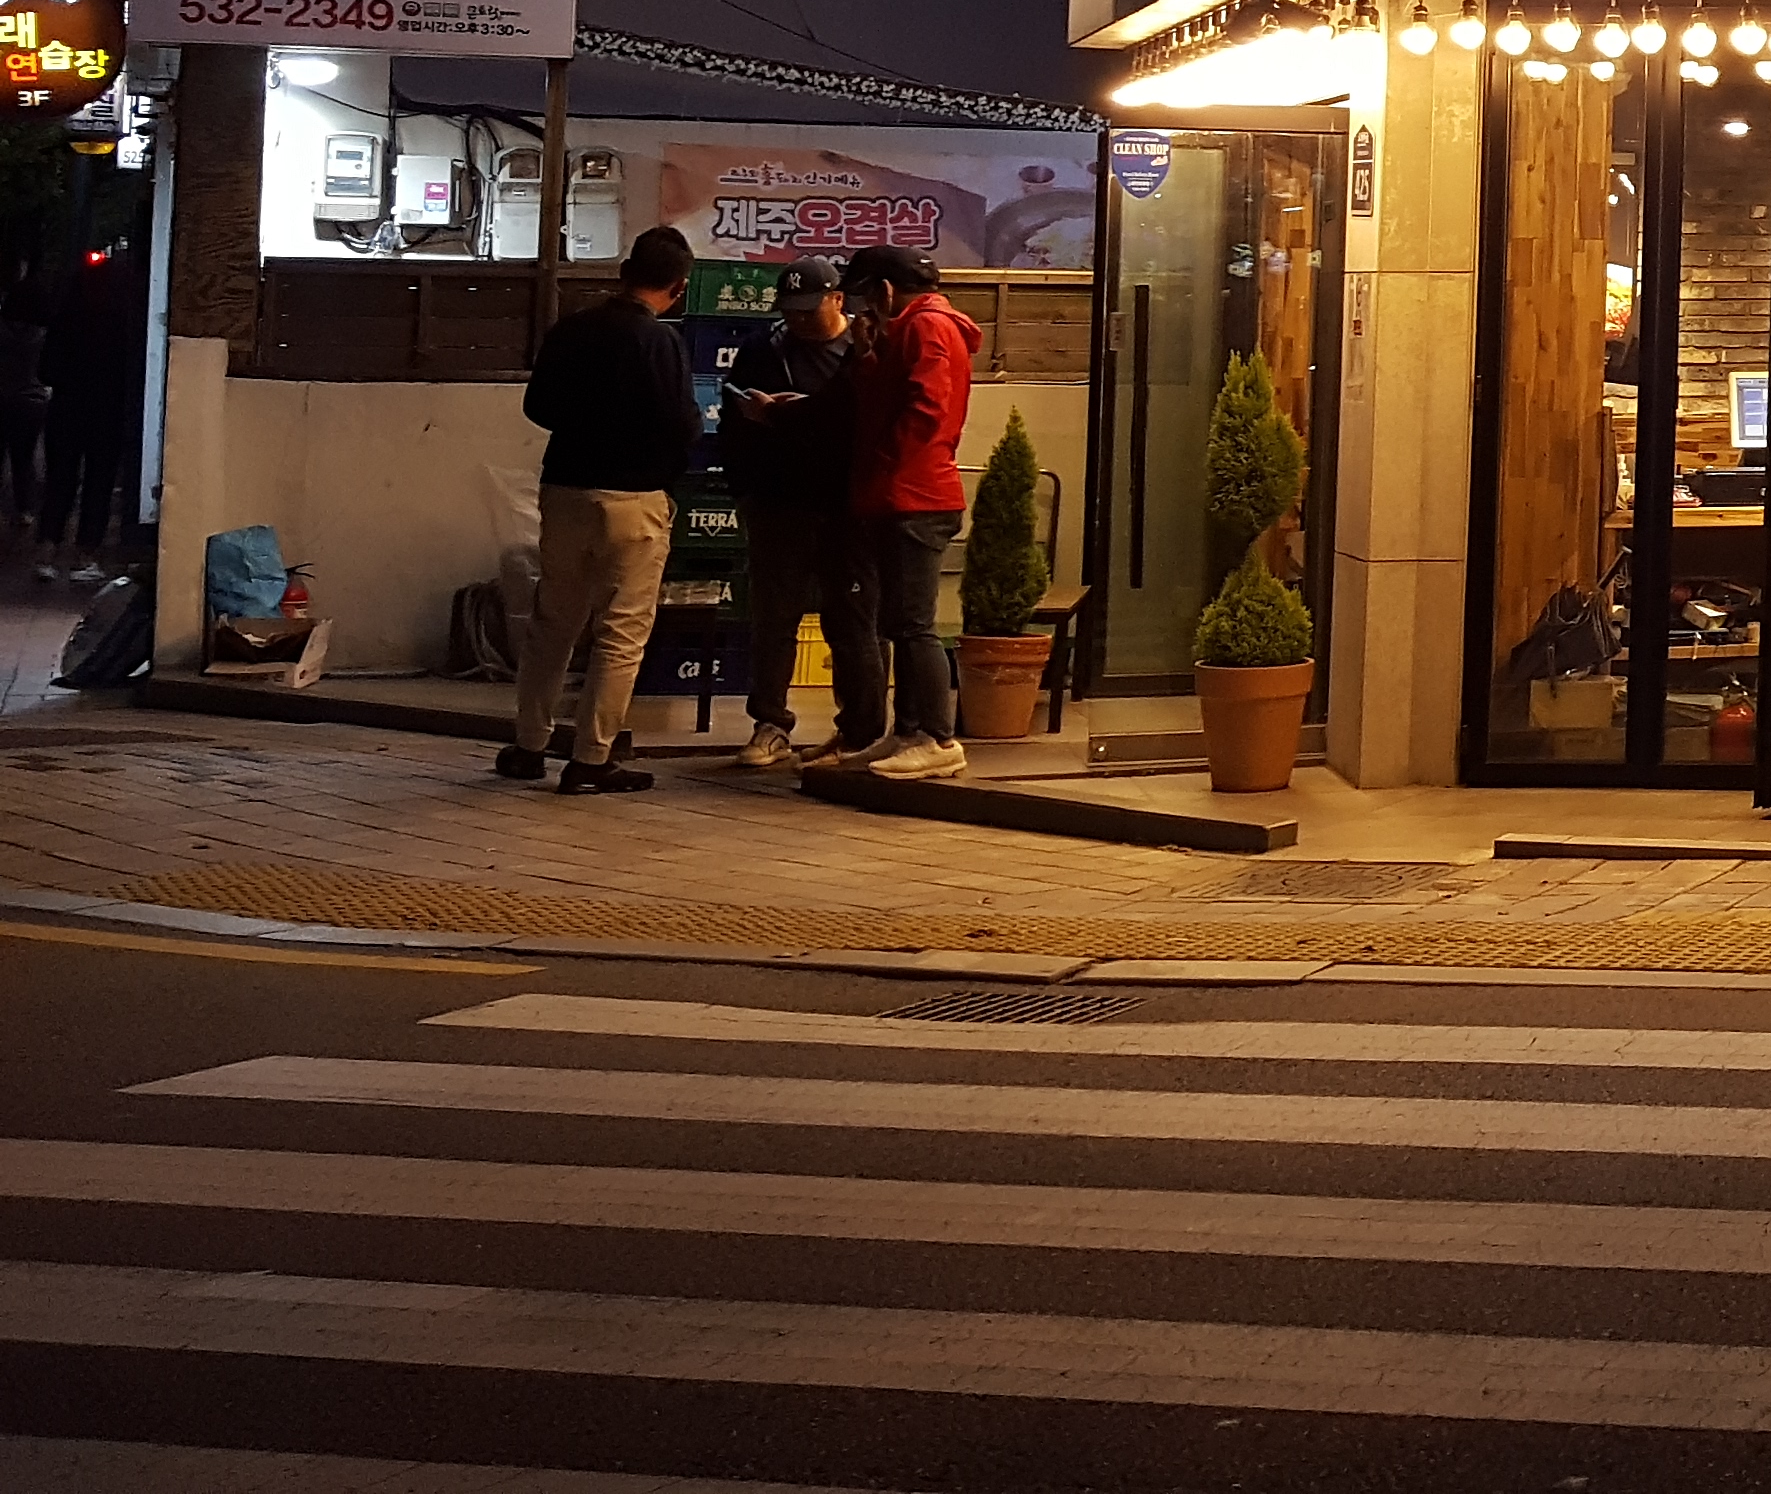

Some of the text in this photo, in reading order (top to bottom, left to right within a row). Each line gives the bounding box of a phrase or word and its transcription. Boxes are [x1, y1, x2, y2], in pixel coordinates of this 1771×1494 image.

[17, 90, 51, 107] 3F
[1113, 142, 1170, 156] CLEAN SHOP
[687, 509, 739, 529] TERRA
